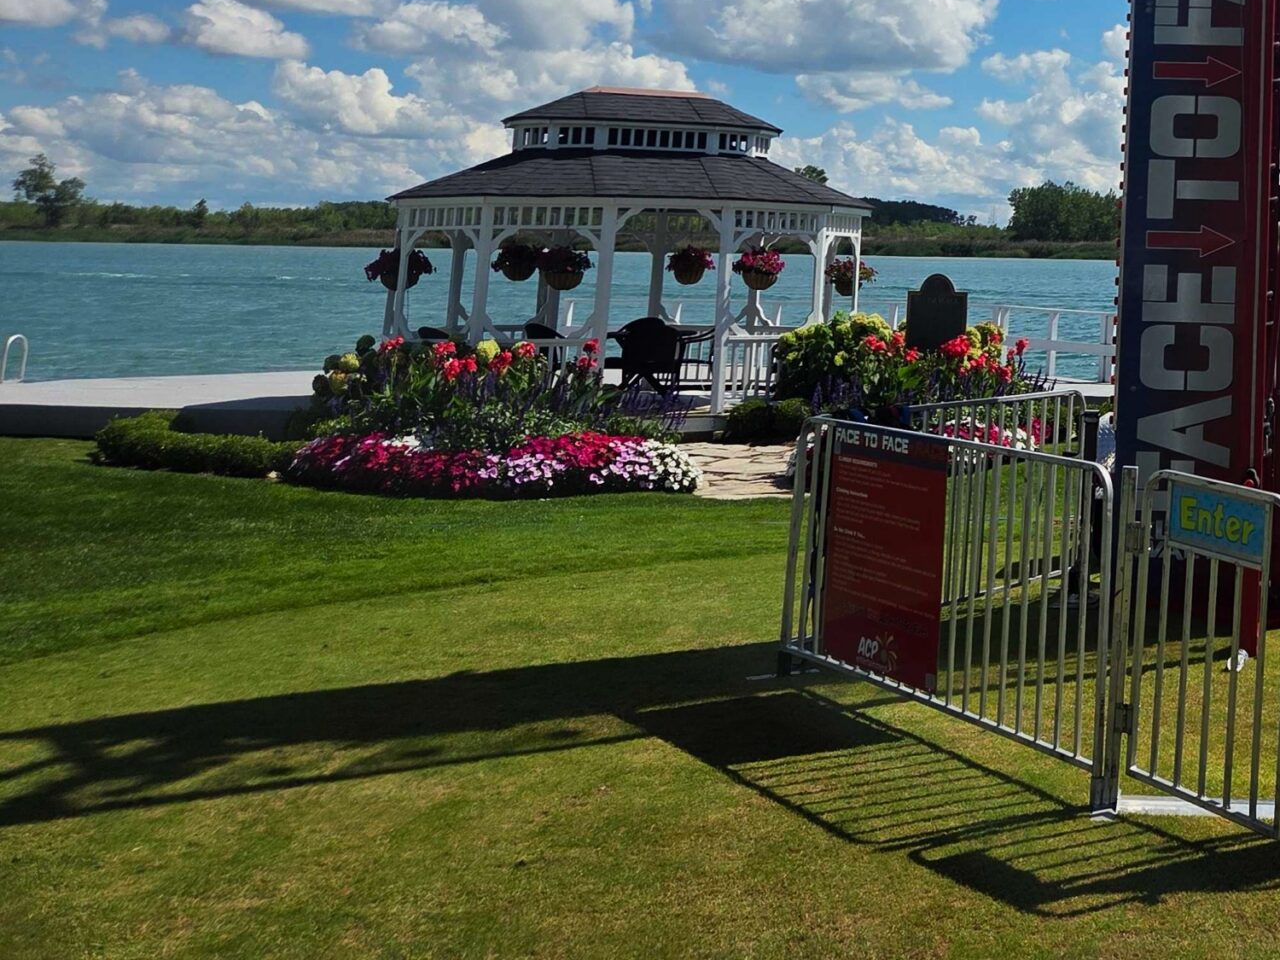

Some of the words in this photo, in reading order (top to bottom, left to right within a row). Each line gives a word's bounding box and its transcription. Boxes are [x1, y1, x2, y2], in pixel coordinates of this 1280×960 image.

[1146, 95, 1241, 219] TO
[835, 427, 860, 446] FACE
[863, 431, 878, 449] TO
[881, 434, 910, 455] FACE
[1179, 495, 1255, 546] Enter
[857, 635, 879, 659] ACP
